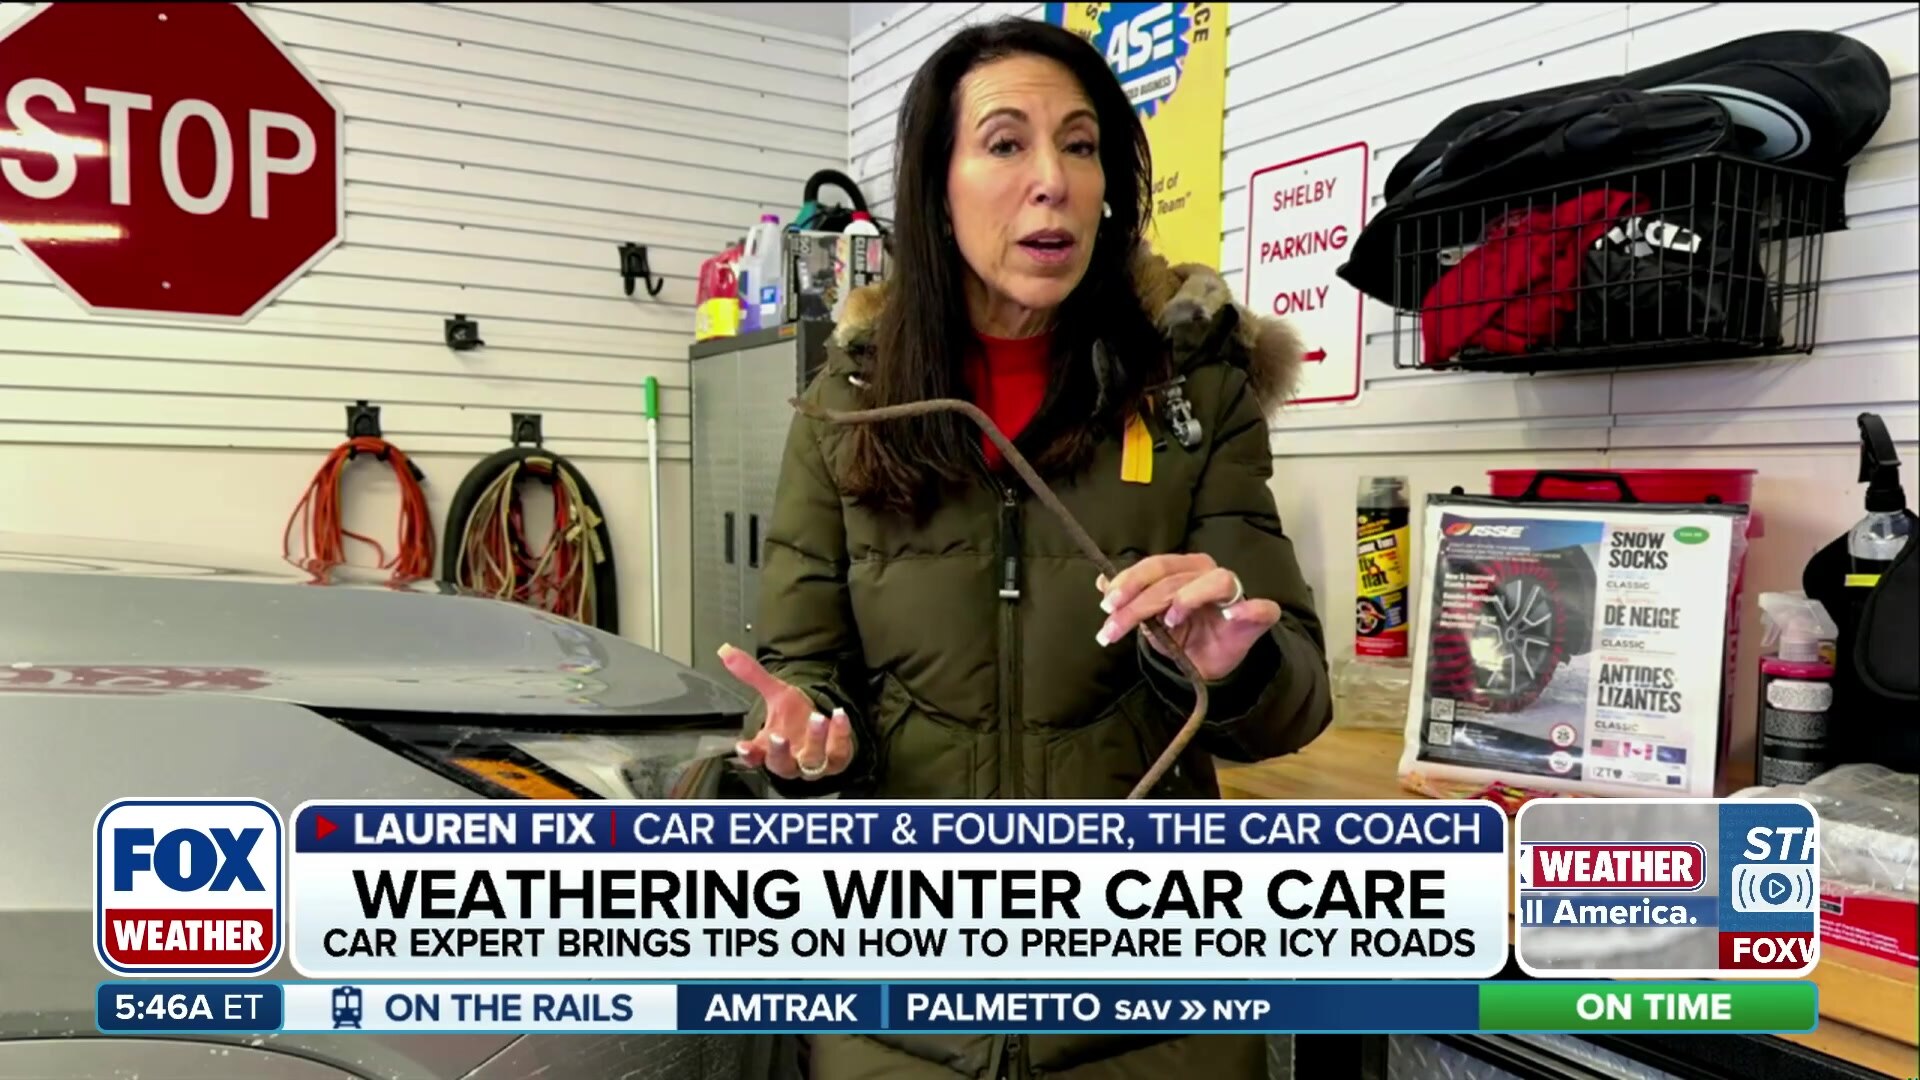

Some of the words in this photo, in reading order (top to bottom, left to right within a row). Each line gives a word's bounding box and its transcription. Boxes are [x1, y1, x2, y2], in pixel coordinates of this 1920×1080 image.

[1105, 2, 1173, 73] ASE
[0, 77, 317, 220] STOP
[1273, 177, 1337, 212] SHELBY
[1260, 225, 1348, 264] PARKING
[1273, 285, 1330, 316] ONLY
[1611, 531, 1665, 549] SNOW
[1608, 549, 1669, 570] SOCKS
[1361, 568, 1390, 590] flat
[1606, 580, 1650, 590] CLASSIC
[1604, 605, 1626, 626] DE
[1629, 606, 1681, 629] NEIGE
[1601, 639, 1645, 649] CLASSIC
[1597, 685, 1682, 713] LIZANTES
[1594, 720, 1639, 731] CLASSIC
